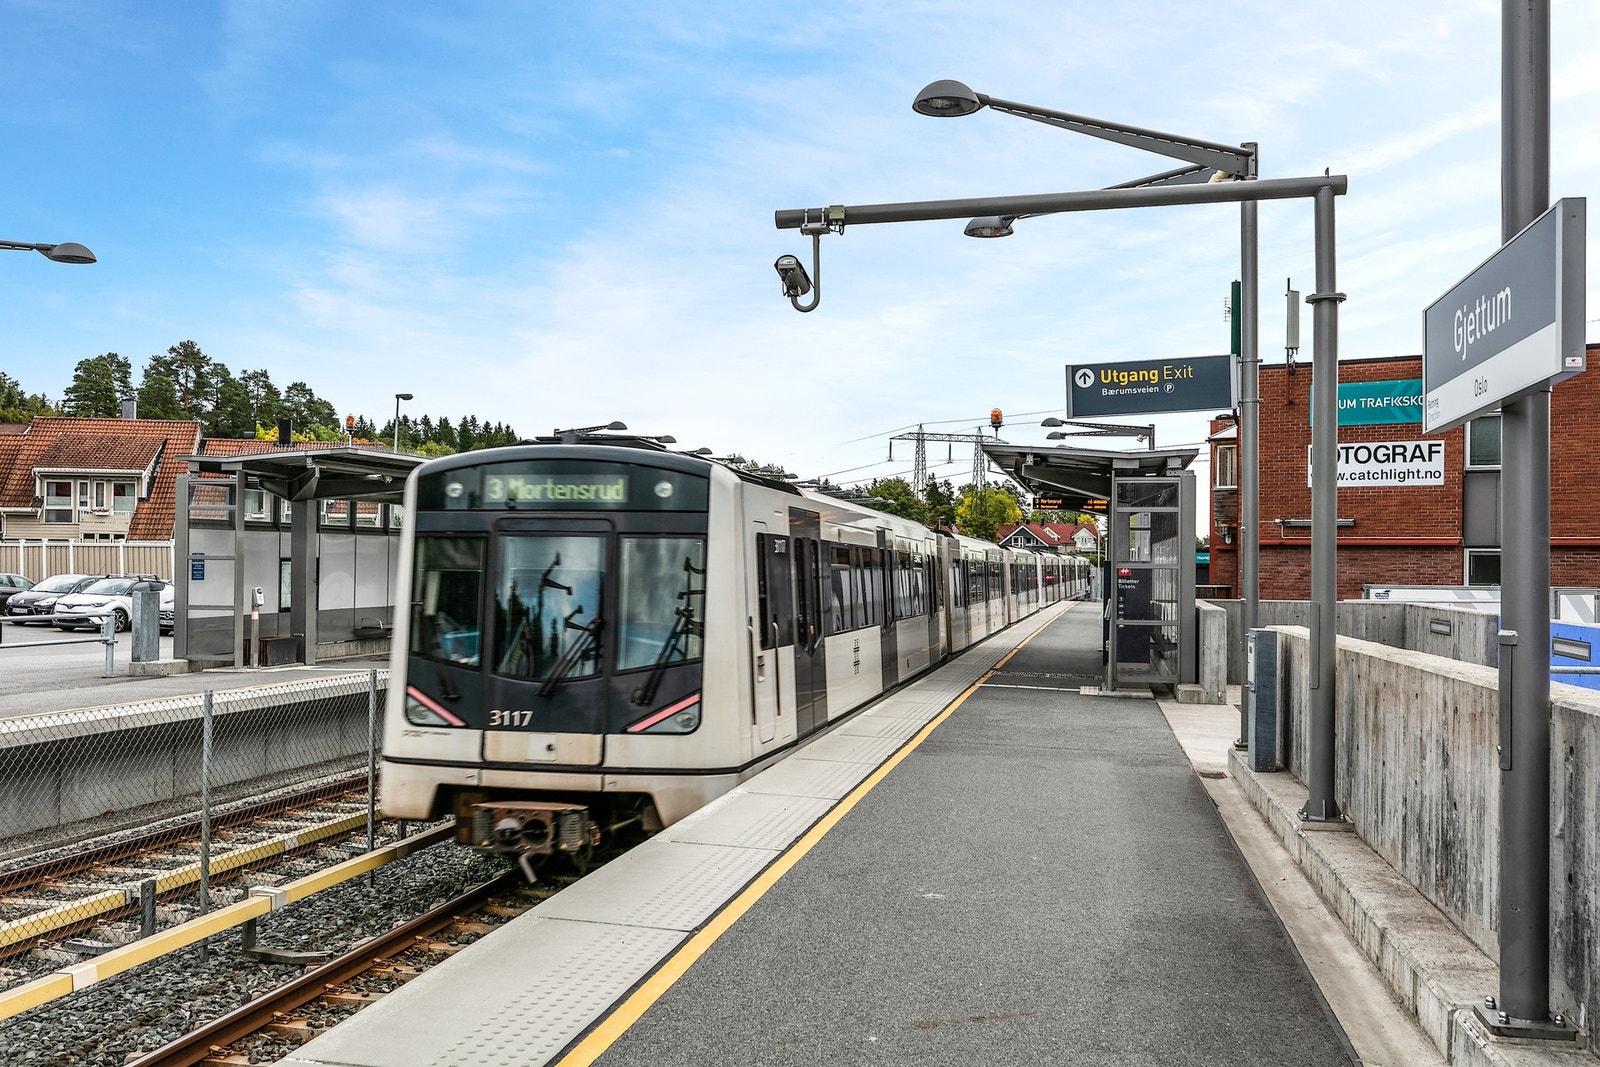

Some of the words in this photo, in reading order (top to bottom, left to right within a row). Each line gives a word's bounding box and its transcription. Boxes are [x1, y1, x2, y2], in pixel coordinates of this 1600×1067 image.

[1454, 286, 1512, 361] Gjettum
[1100, 368, 1159, 386] Utgang
[1163, 364, 1193, 380] Exit
[1102, 385, 1159, 396] Bærumsveien
[1474, 376, 1488, 397] Oslo
[1338, 399, 1356, 409] UM
[1310, 443, 1442, 465] TOGRAF
[1311, 469, 1441, 482] w.catchlight.no
[489, 478, 503, 499] 3
[508, 478, 625, 500] Mortensrud
[488, 709, 534, 727] 3117
